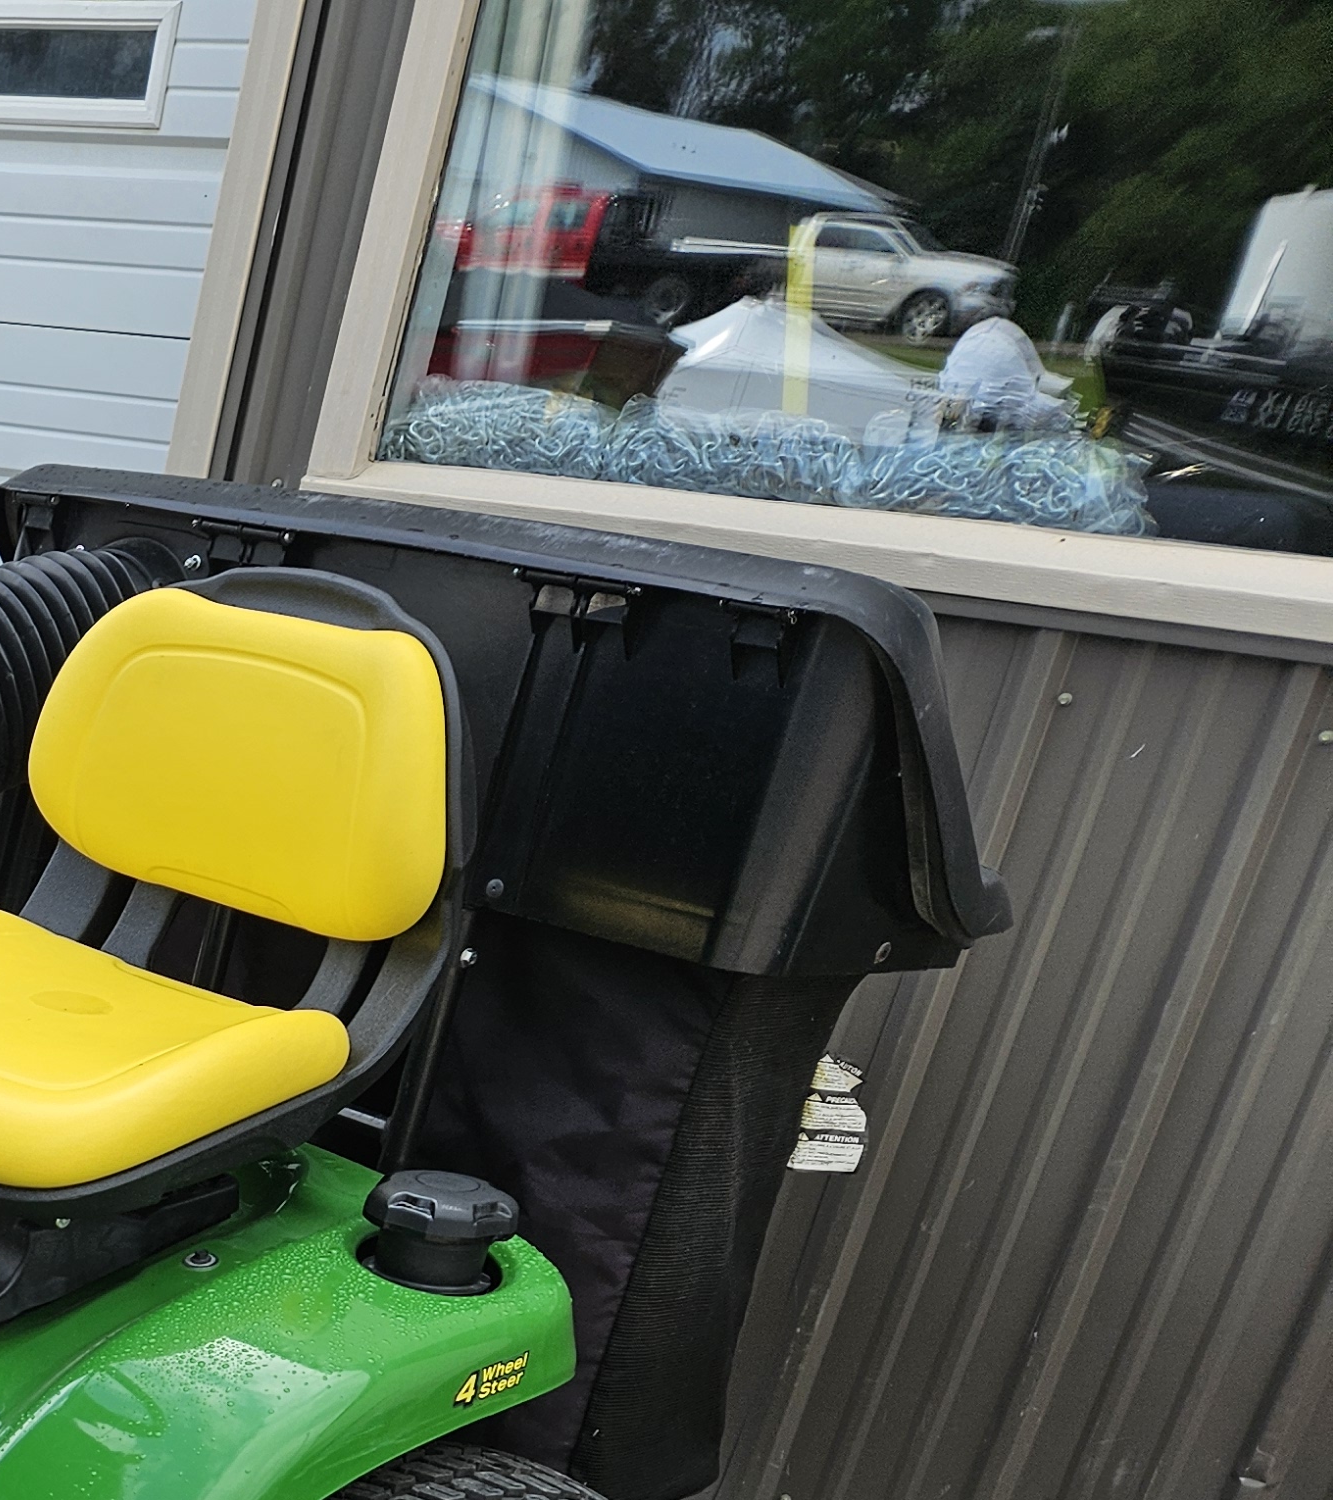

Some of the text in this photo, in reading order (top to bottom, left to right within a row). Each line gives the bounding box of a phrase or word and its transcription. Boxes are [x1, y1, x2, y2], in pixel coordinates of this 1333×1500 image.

[814, 1134, 860, 1143] ATTENTION
[453, 1351, 529, 1406] 4 Wheel
[478, 1371, 524, 1401] Steer
